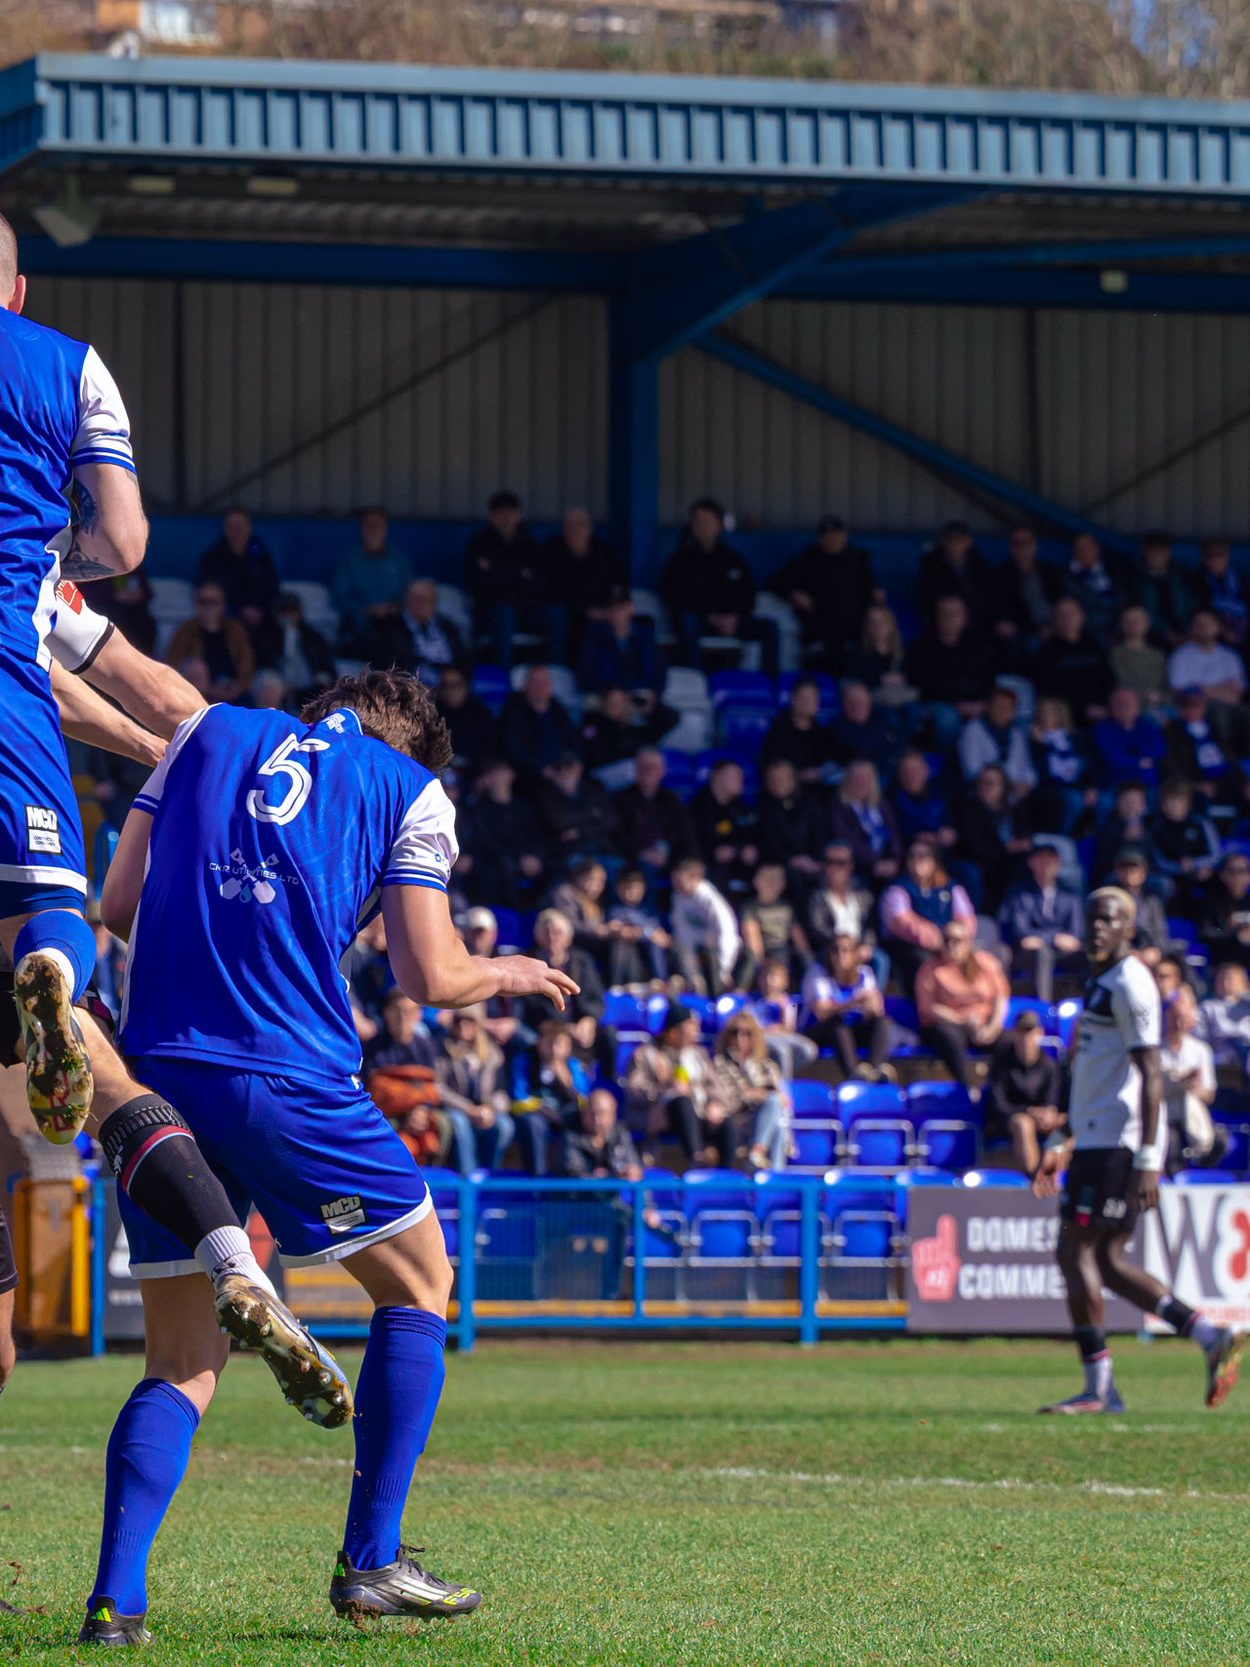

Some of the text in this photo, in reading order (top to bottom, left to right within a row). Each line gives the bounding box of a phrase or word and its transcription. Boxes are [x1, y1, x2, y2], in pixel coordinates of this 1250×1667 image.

[246, 733, 330, 825] 5
[209, 862, 299, 885] CKR UTILITIES LTD
[321, 1196, 361, 1218] MCD
